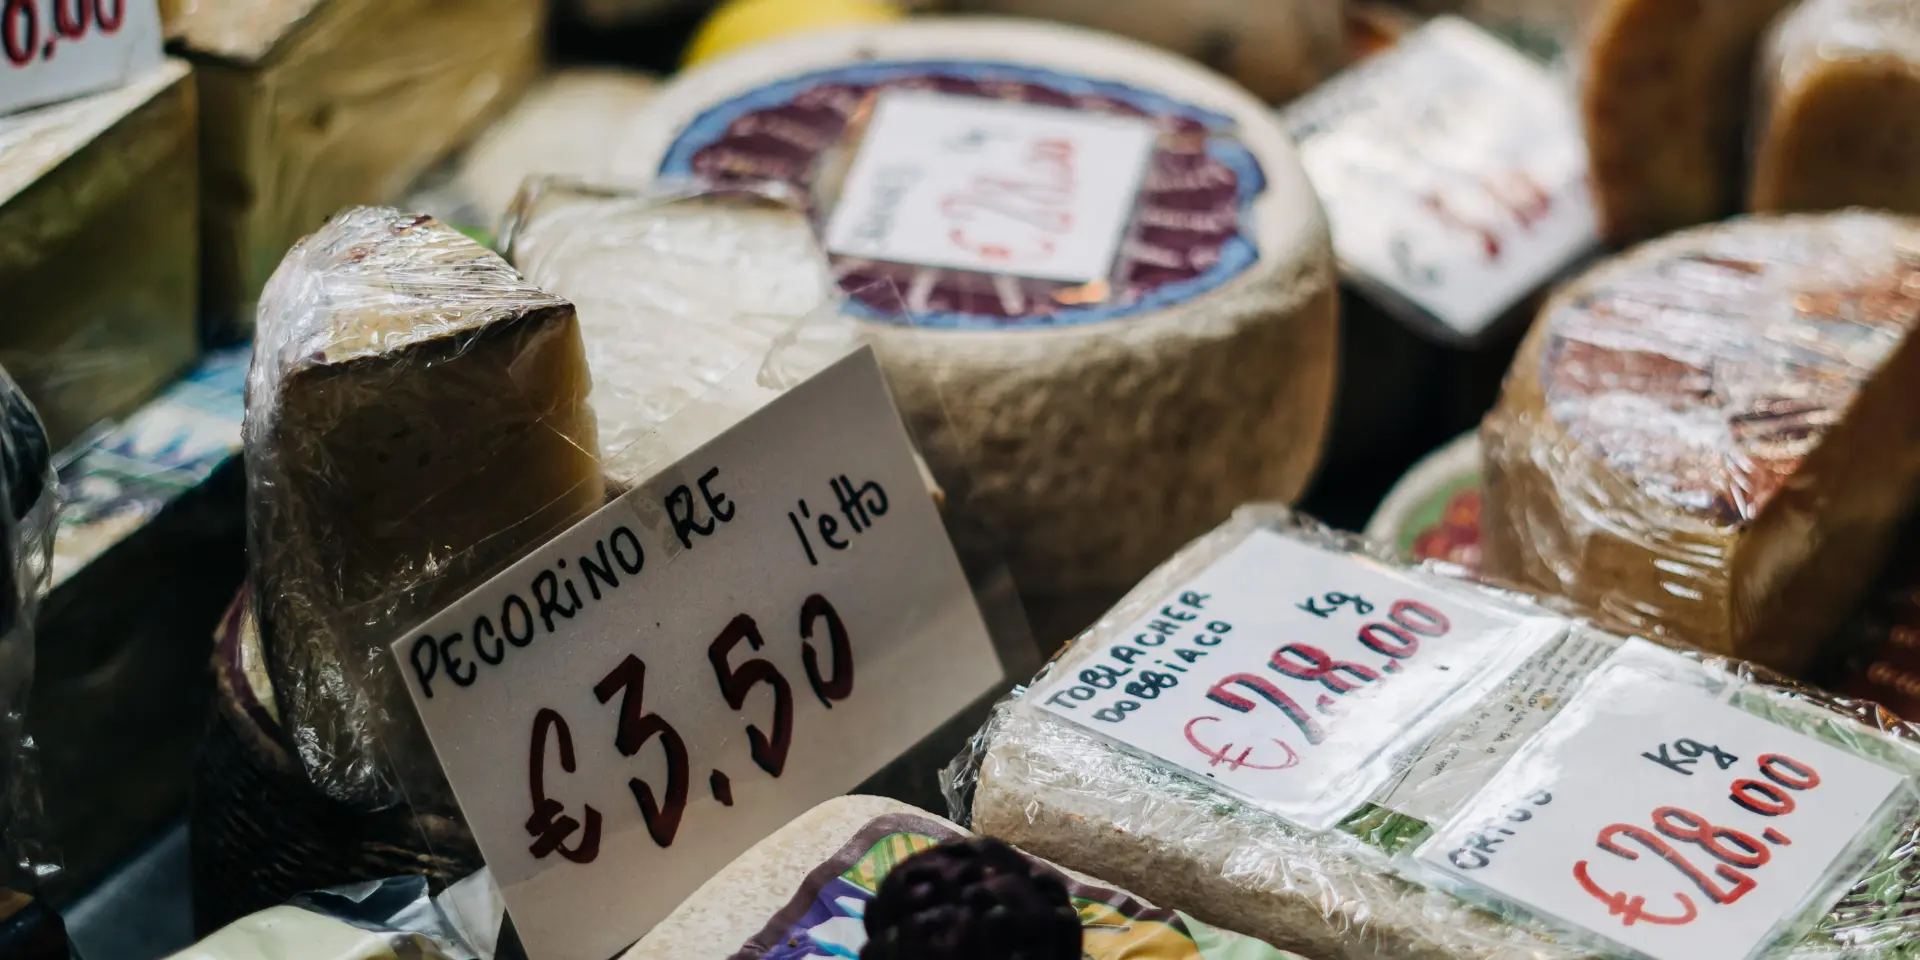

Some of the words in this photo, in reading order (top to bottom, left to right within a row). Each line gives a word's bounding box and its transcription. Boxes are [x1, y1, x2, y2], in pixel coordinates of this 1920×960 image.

[663, 466, 736, 550] RE
[787, 473, 890, 566] l'etto
[1045, 590, 1212, 709] TOBLACHER
